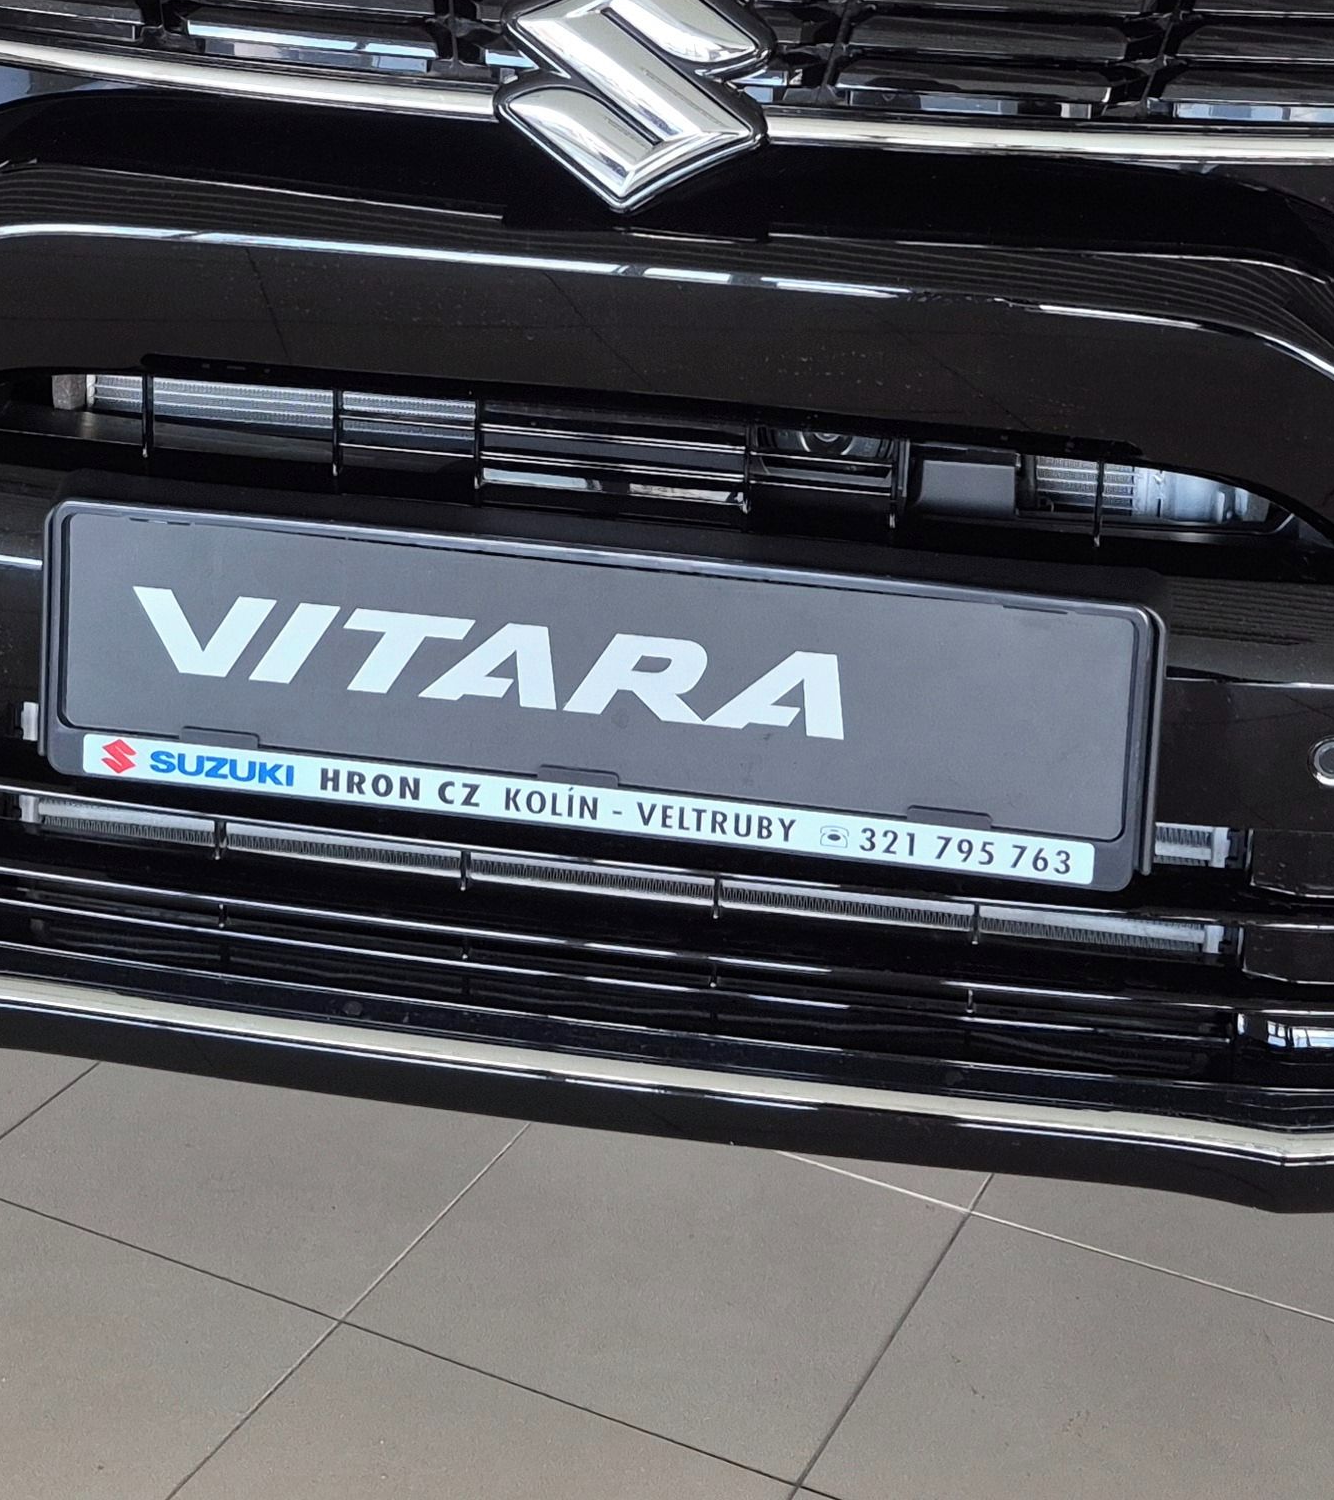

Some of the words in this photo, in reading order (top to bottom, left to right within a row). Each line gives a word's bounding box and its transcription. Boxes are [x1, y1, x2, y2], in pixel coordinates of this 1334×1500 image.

[132, 585, 845, 741] VITARA
[149, 749, 295, 787] SUZUKI
[320, 767, 421, 802] HRON
[437, 780, 481, 807] CZ
[504, 787, 599, 821] KOLÍN
[636, 801, 797, 843] VELTRUBY
[858, 827, 916, 857] 321
[934, 836, 995, 866] 795
[1009, 844, 1072, 875] 763
